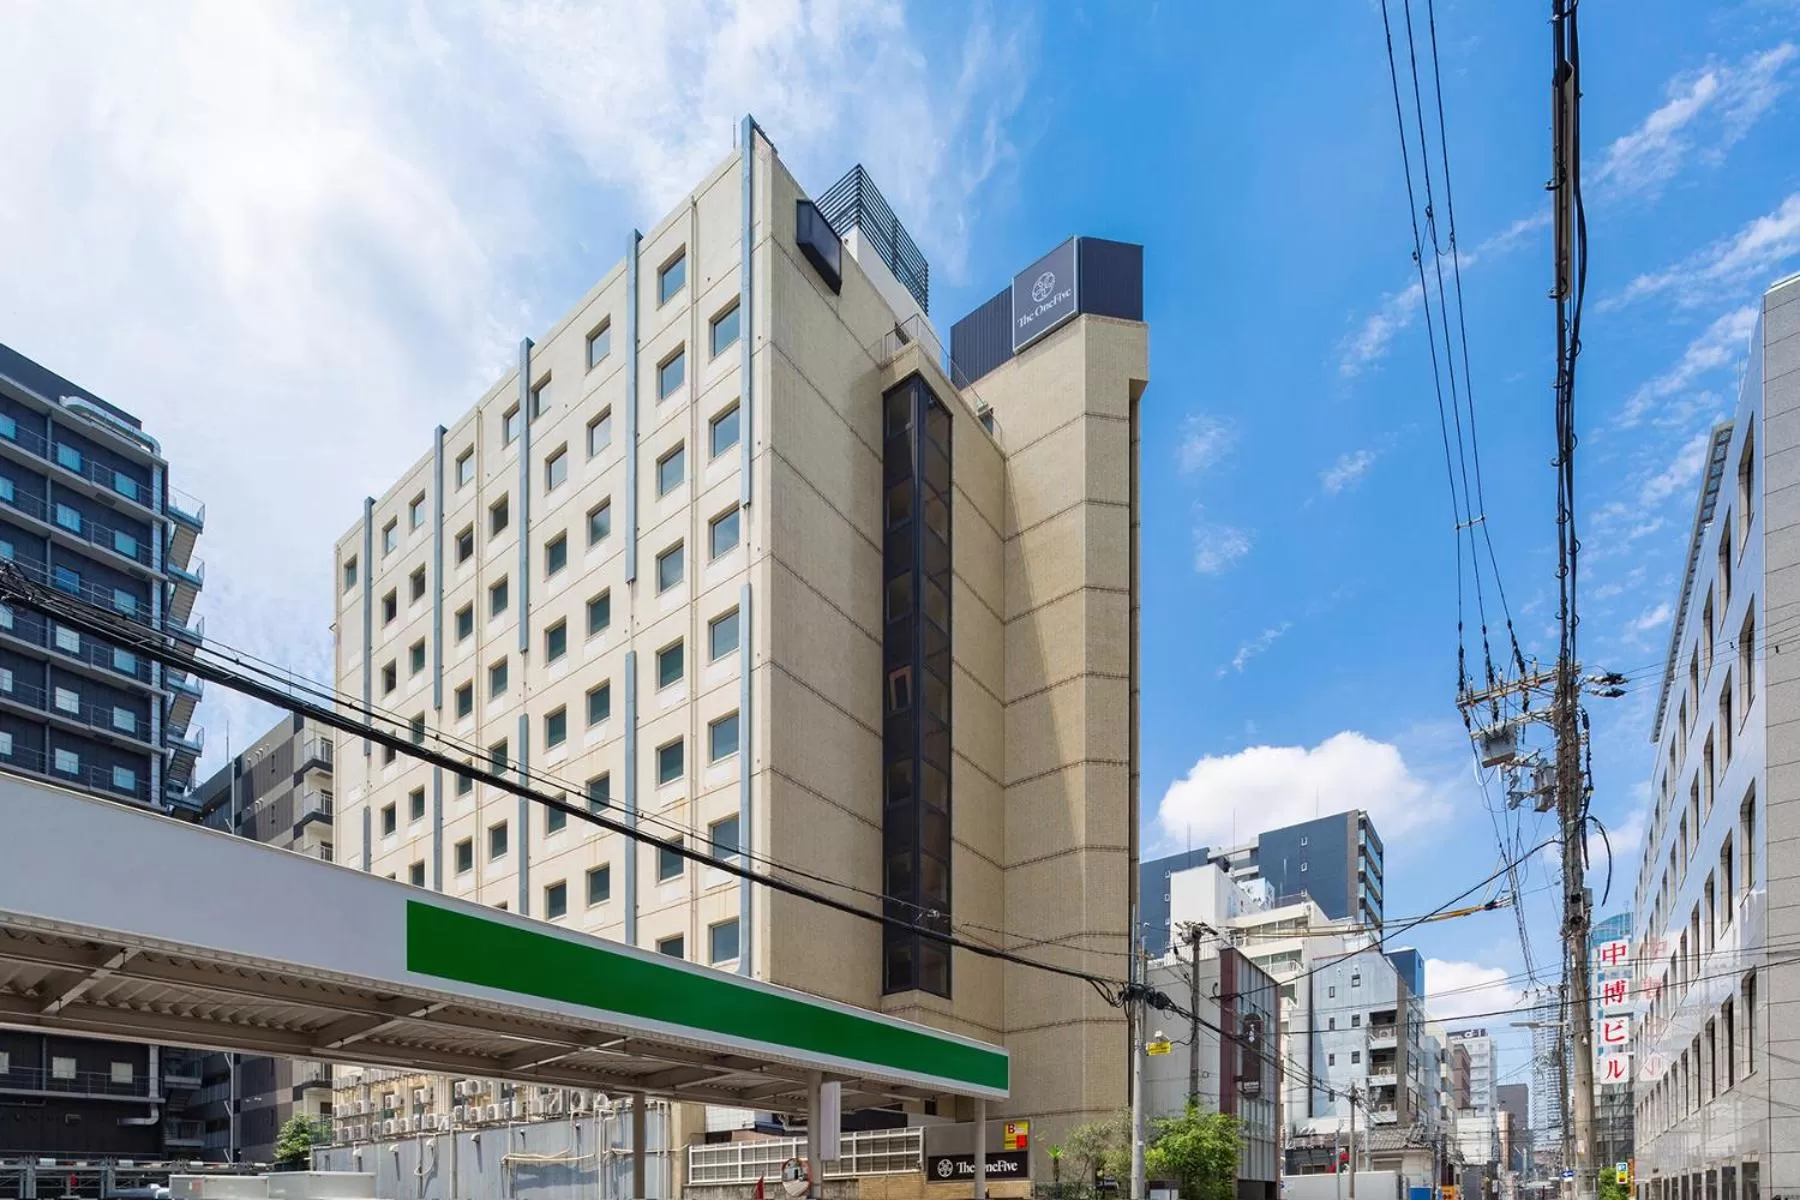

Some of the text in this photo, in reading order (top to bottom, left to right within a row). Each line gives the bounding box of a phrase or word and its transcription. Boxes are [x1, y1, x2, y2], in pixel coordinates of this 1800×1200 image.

[1602, 942, 1626, 1079] 中博ビル
[984, 1160, 1018, 1172] neFive
